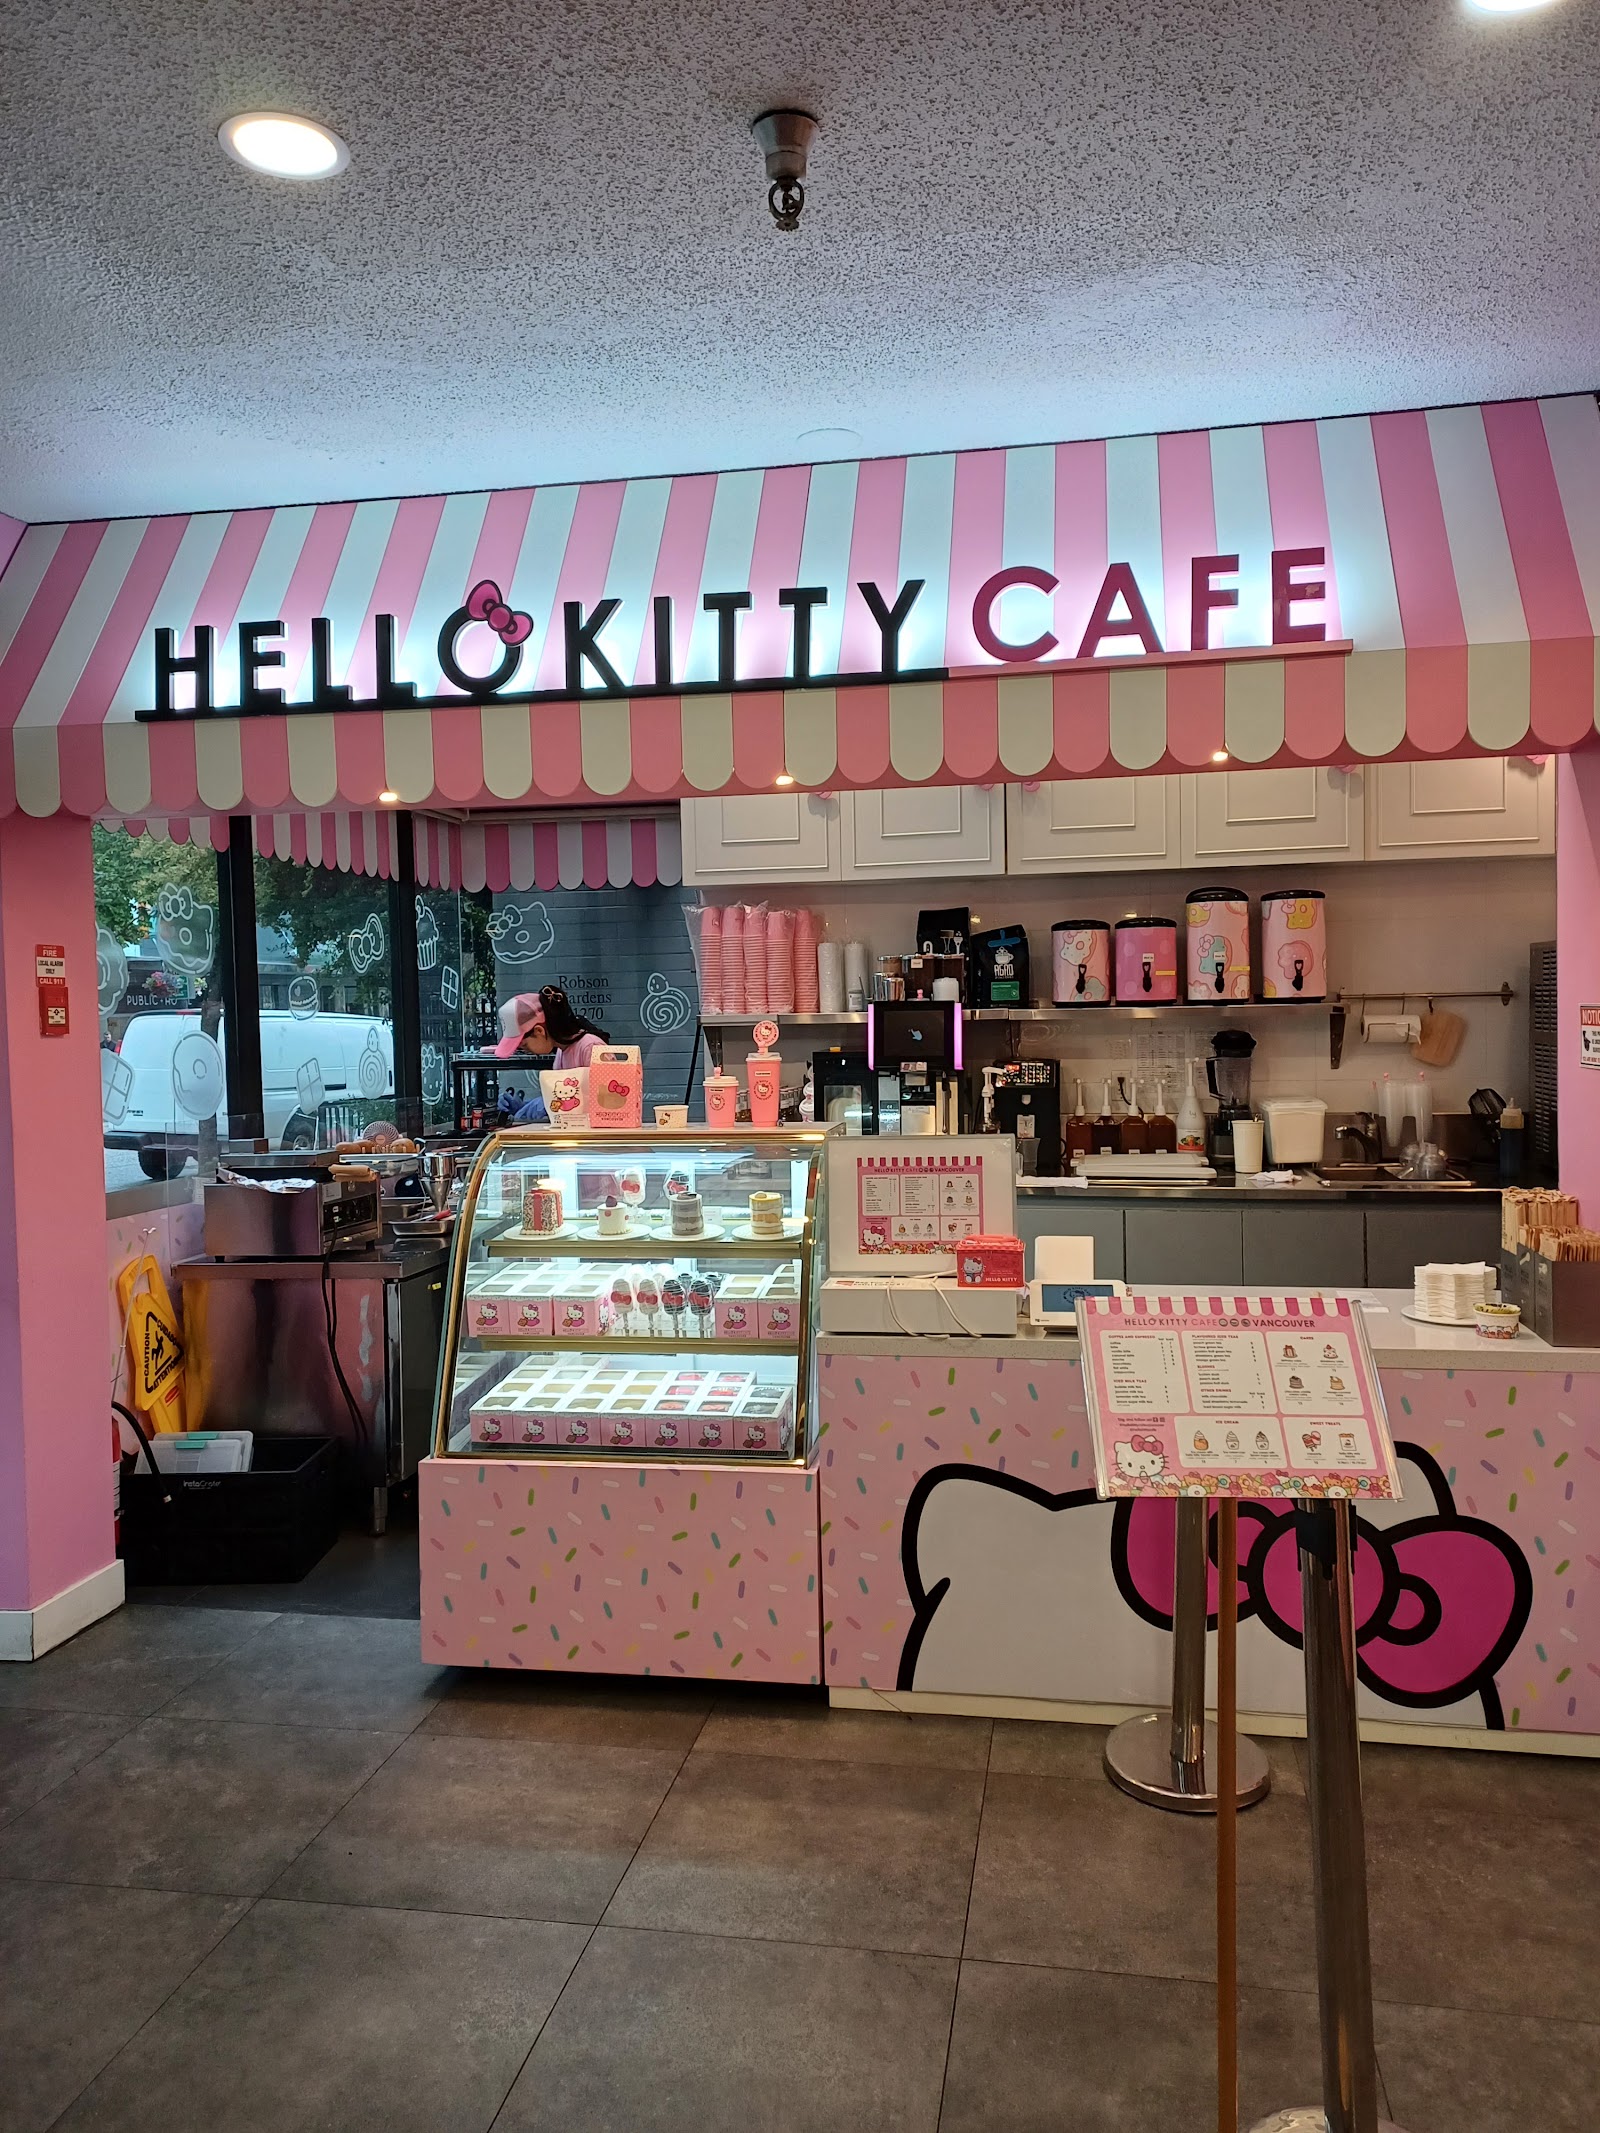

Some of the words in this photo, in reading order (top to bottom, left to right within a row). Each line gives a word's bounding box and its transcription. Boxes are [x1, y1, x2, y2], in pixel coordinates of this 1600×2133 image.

[155, 603, 524, 711] HELLO
[564, 580, 925, 690] KITTY
[972, 547, 1326, 662] CAFE
[43, 949, 57, 957] FIRE
[559, 976, 609, 988] Robson
[127, 995, 158, 1005] PUBLIC
[568, 992, 611, 1004] ardens
[1124, 1318, 1157, 1326] HELLO
[1191, 1319, 1217, 1327] CAFE
[1252, 1319, 1316, 1328] VANCOUVER
[157, 1320, 177, 1345] CUIDADO
